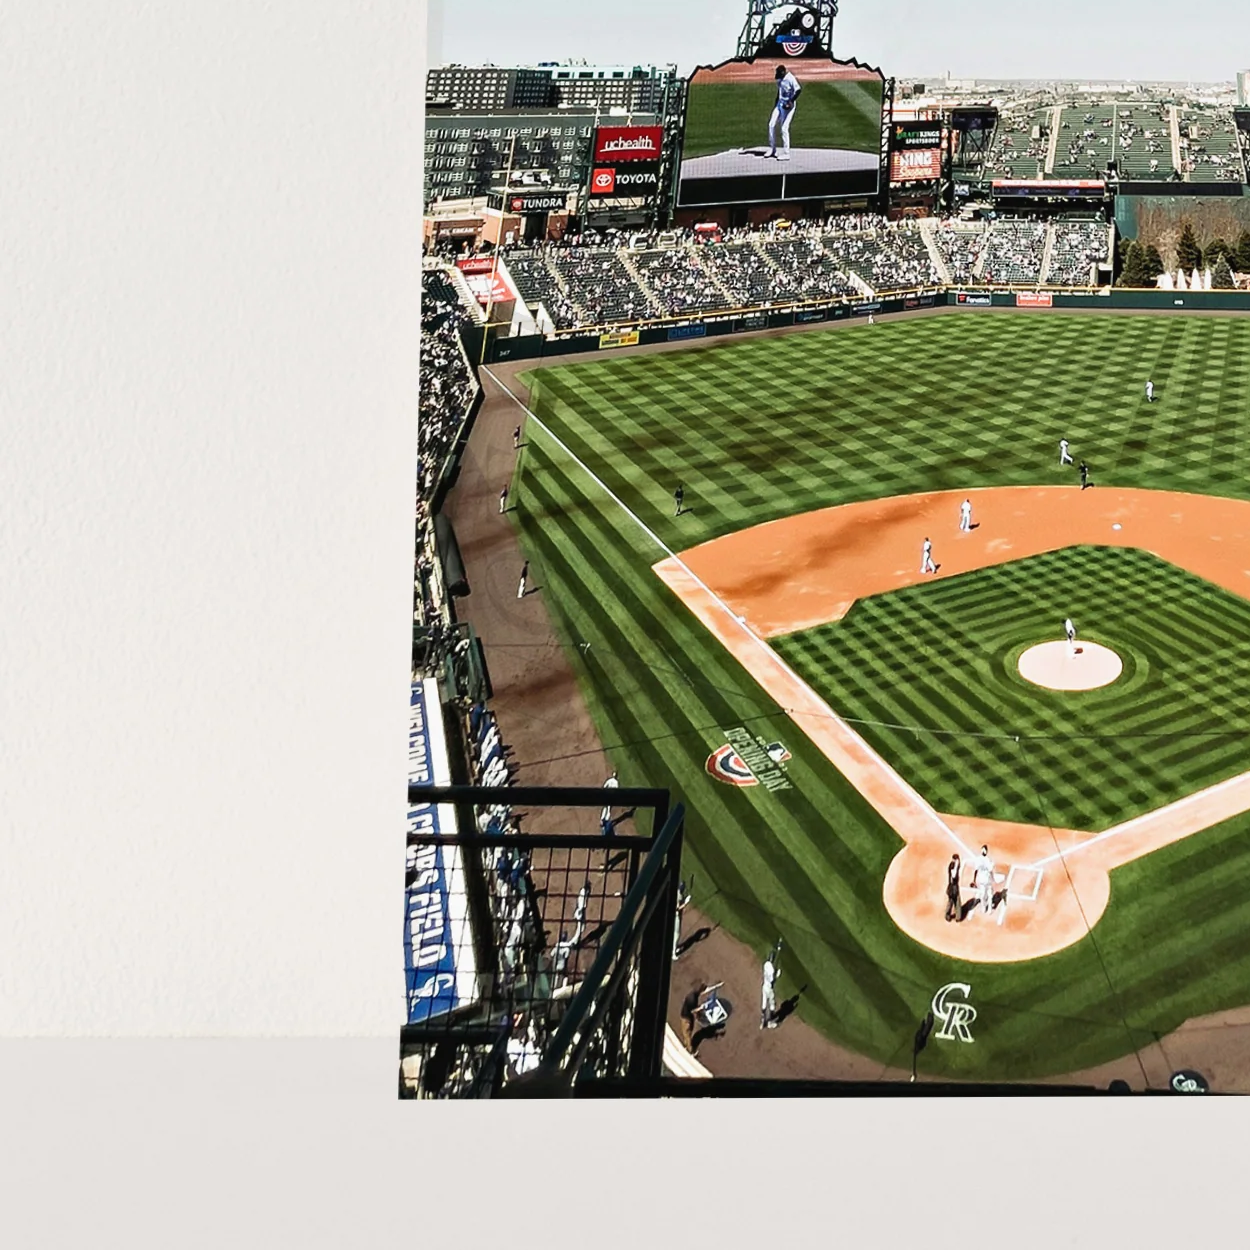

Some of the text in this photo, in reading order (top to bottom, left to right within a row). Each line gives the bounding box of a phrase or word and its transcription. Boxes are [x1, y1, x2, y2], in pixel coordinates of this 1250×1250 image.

[604, 135, 653, 150] uchealth
[615, 173, 657, 185] TOYOTA
[522, 197, 563, 209] TUNDRA
[723, 727, 794, 792] OPENING DAY
[409, 890, 447, 968] FIELD
